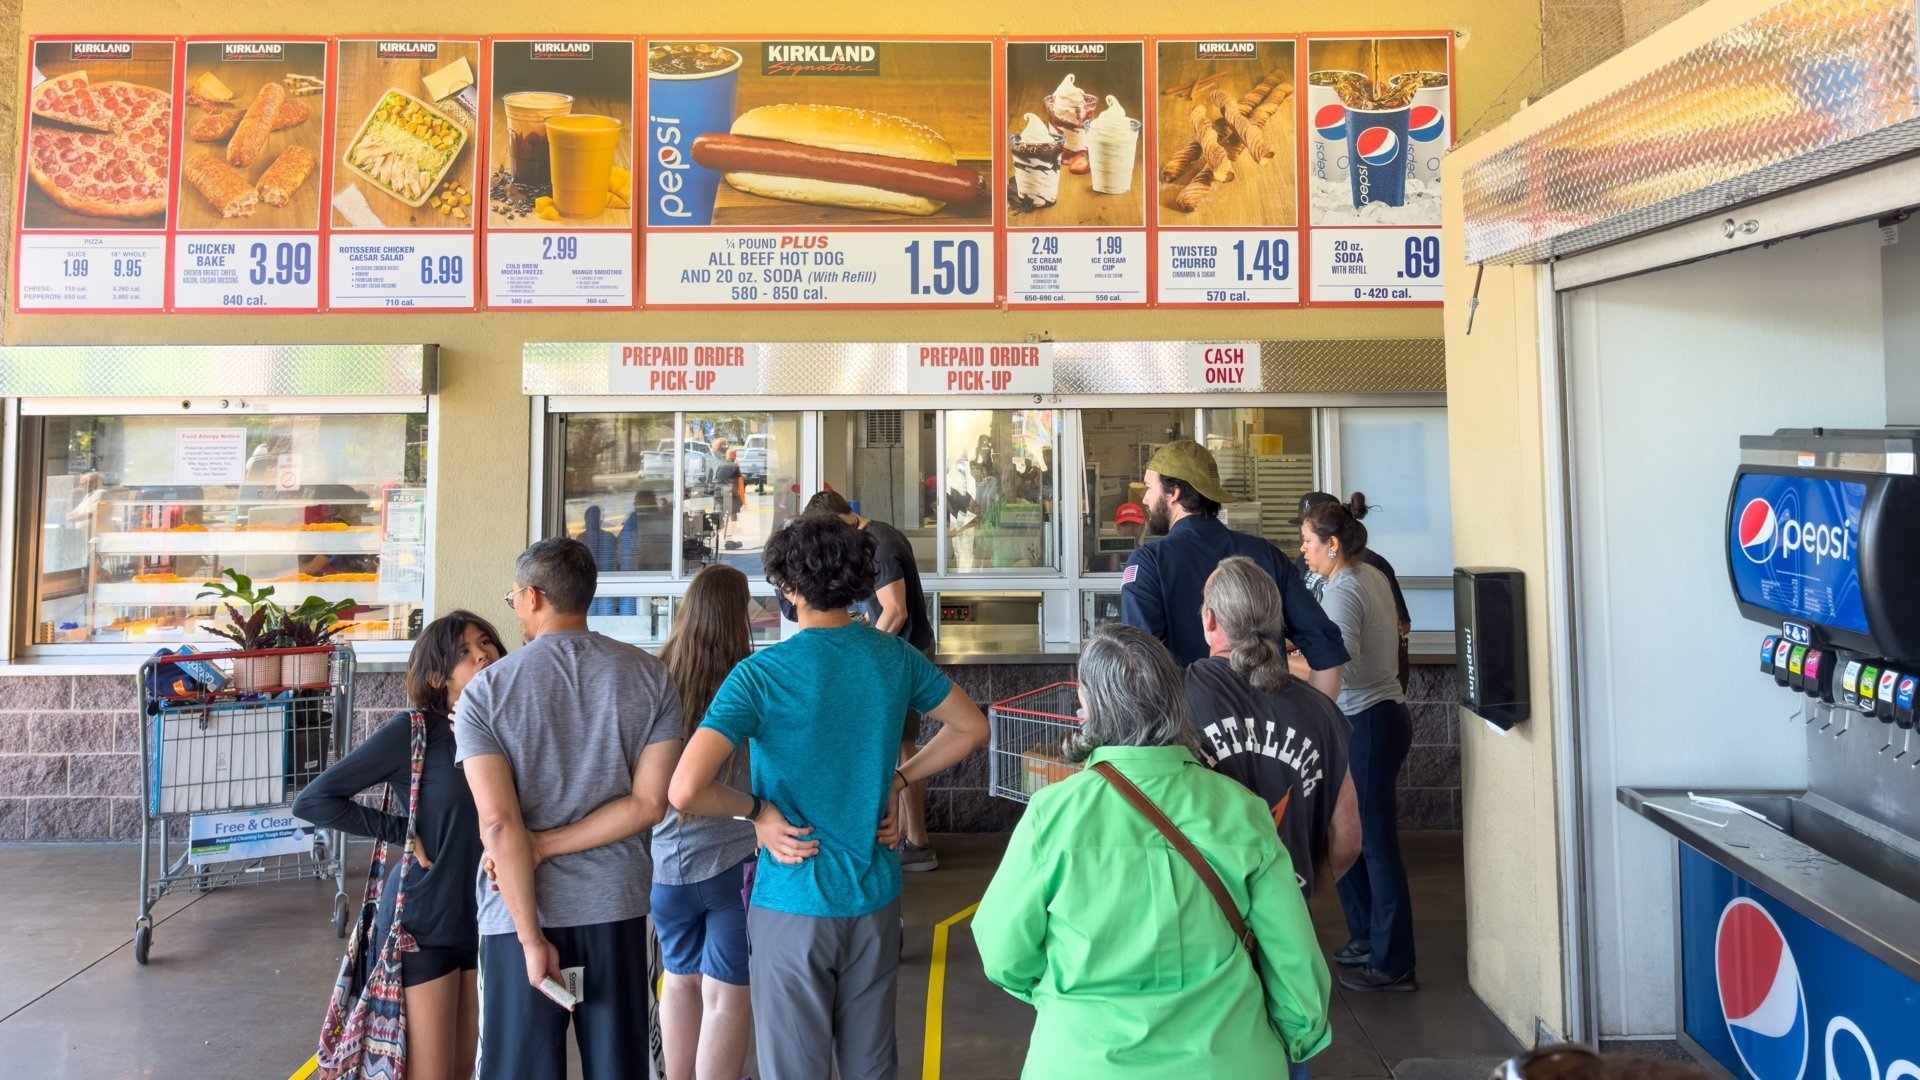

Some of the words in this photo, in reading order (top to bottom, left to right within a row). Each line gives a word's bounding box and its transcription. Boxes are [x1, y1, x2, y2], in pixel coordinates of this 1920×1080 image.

[74, 44, 130, 52] KIRKLAND
[226, 44, 282, 53] KIRKLAND
[380, 44, 436, 52] KIRKLAND
[535, 44, 590, 52] KIRKLAND
[768, 46, 875, 62] KIRKLAND
[1050, 44, 1104, 53] KIRKLAND
[1200, 44, 1254, 52] KIRKLAND
[768, 62, 874, 76] Signature
[650, 116, 692, 218] pepsi
[1357, 164, 1372, 207] pepsi
[188, 244, 235, 254] CHICKEN
[340, 246, 380, 254] ROTISSERIE
[383, 246, 414, 254] CHICKEN
[542, 236, 578, 260] 2.99
[738, 238, 776, 249] POUND
[780, 236, 828, 249] PLUS
[1032, 236, 1058, 254] 2.49
[1096, 236, 1122, 254] 1.99
[1334, 240, 1348, 251] 20
[1350, 243, 1364, 251] oz.
[708, 252, 736, 266] ALL
[740, 252, 775, 266] BEEF
[780, 252, 808, 266] HOT
[814, 252, 844, 266] DOG
[1170, 246, 1218, 256] TWISTED
[1334, 252, 1364, 264] SODA
[1396, 236, 1440, 278] .69
[64, 259, 88, 276] 1.99
[196, 256, 226, 266] BAKE
[250, 242, 312, 285] 3.99
[1172, 258, 1216, 268] CHURRO
[1232, 239, 1290, 280] 1.49
[114, 260, 142, 277] 9.95
[421, 256, 463, 284] 6.99
[904, 240, 980, 296] 1.50
[1332, 266, 1347, 274] WITH
[1348, 266, 1367, 274] REFILL
[680, 269, 710, 283] AND
[716, 269, 733, 283] 20
[738, 272, 758, 283] oz.
[763, 269, 803, 283] SODA
[808, 271, 838, 285] (With
[842, 271, 877, 285] Refill)
[223, 294, 242, 306] 840
[246, 295, 267, 306] cal.
[732, 286, 758, 300] 580
[772, 286, 799, 300] 850
[803, 286, 828, 300] cal.
[1206, 290, 1226, 301] 570
[1230, 290, 1250, 301] cal.
[1392, 288, 1412, 299] cal.
[622, 346, 688, 366] PREPAID
[694, 346, 744, 366] ORDER
[920, 346, 984, 366] PREPAID
[990, 346, 1040, 366] ORDER
[1204, 348, 1244, 364] CASH
[650, 370, 716, 390] PICK-UP
[948, 370, 1012, 390] PICK-UP
[1206, 368, 1244, 384] ONLY
[1782, 518, 1850, 566] pepsi
[1466, 634, 1475, 699] napkins
[1200, 716, 1323, 798] ETALLICA
[216, 822, 244, 834] Free
[248, 819, 258, 830] &
[261, 816, 294, 829] Clear
